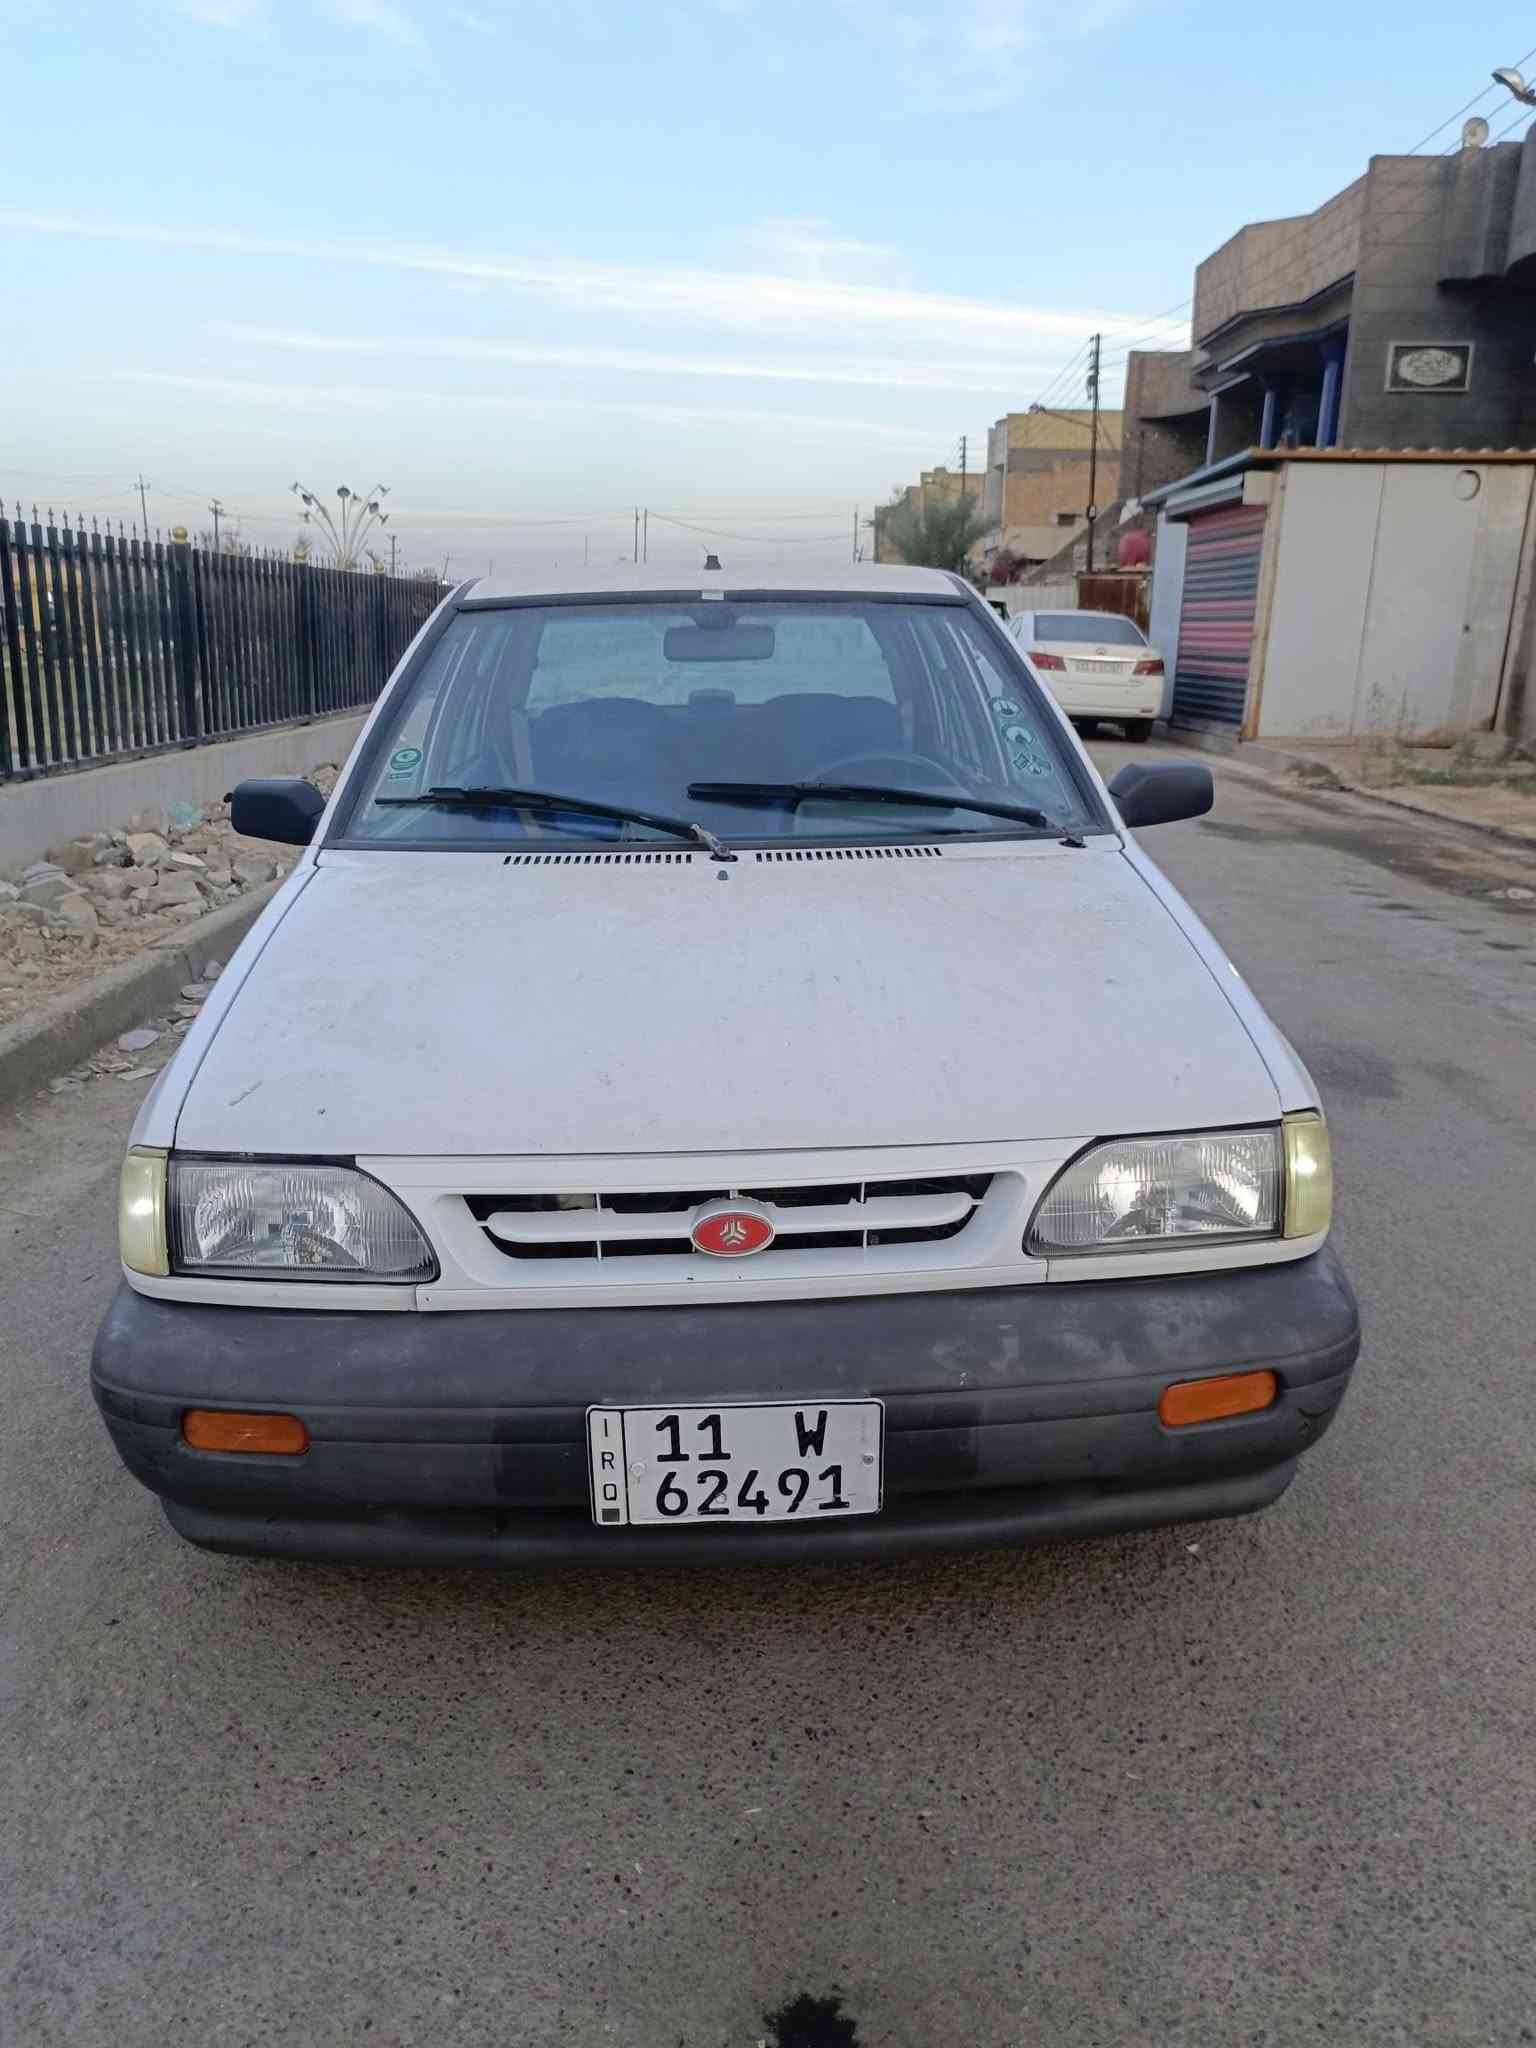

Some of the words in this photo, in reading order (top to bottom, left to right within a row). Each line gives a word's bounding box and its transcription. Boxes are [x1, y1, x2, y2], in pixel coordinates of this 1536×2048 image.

[655, 1414, 731, 1462] 11
[794, 1410, 828, 1457] W
[656, 1465, 850, 1516] 62491
